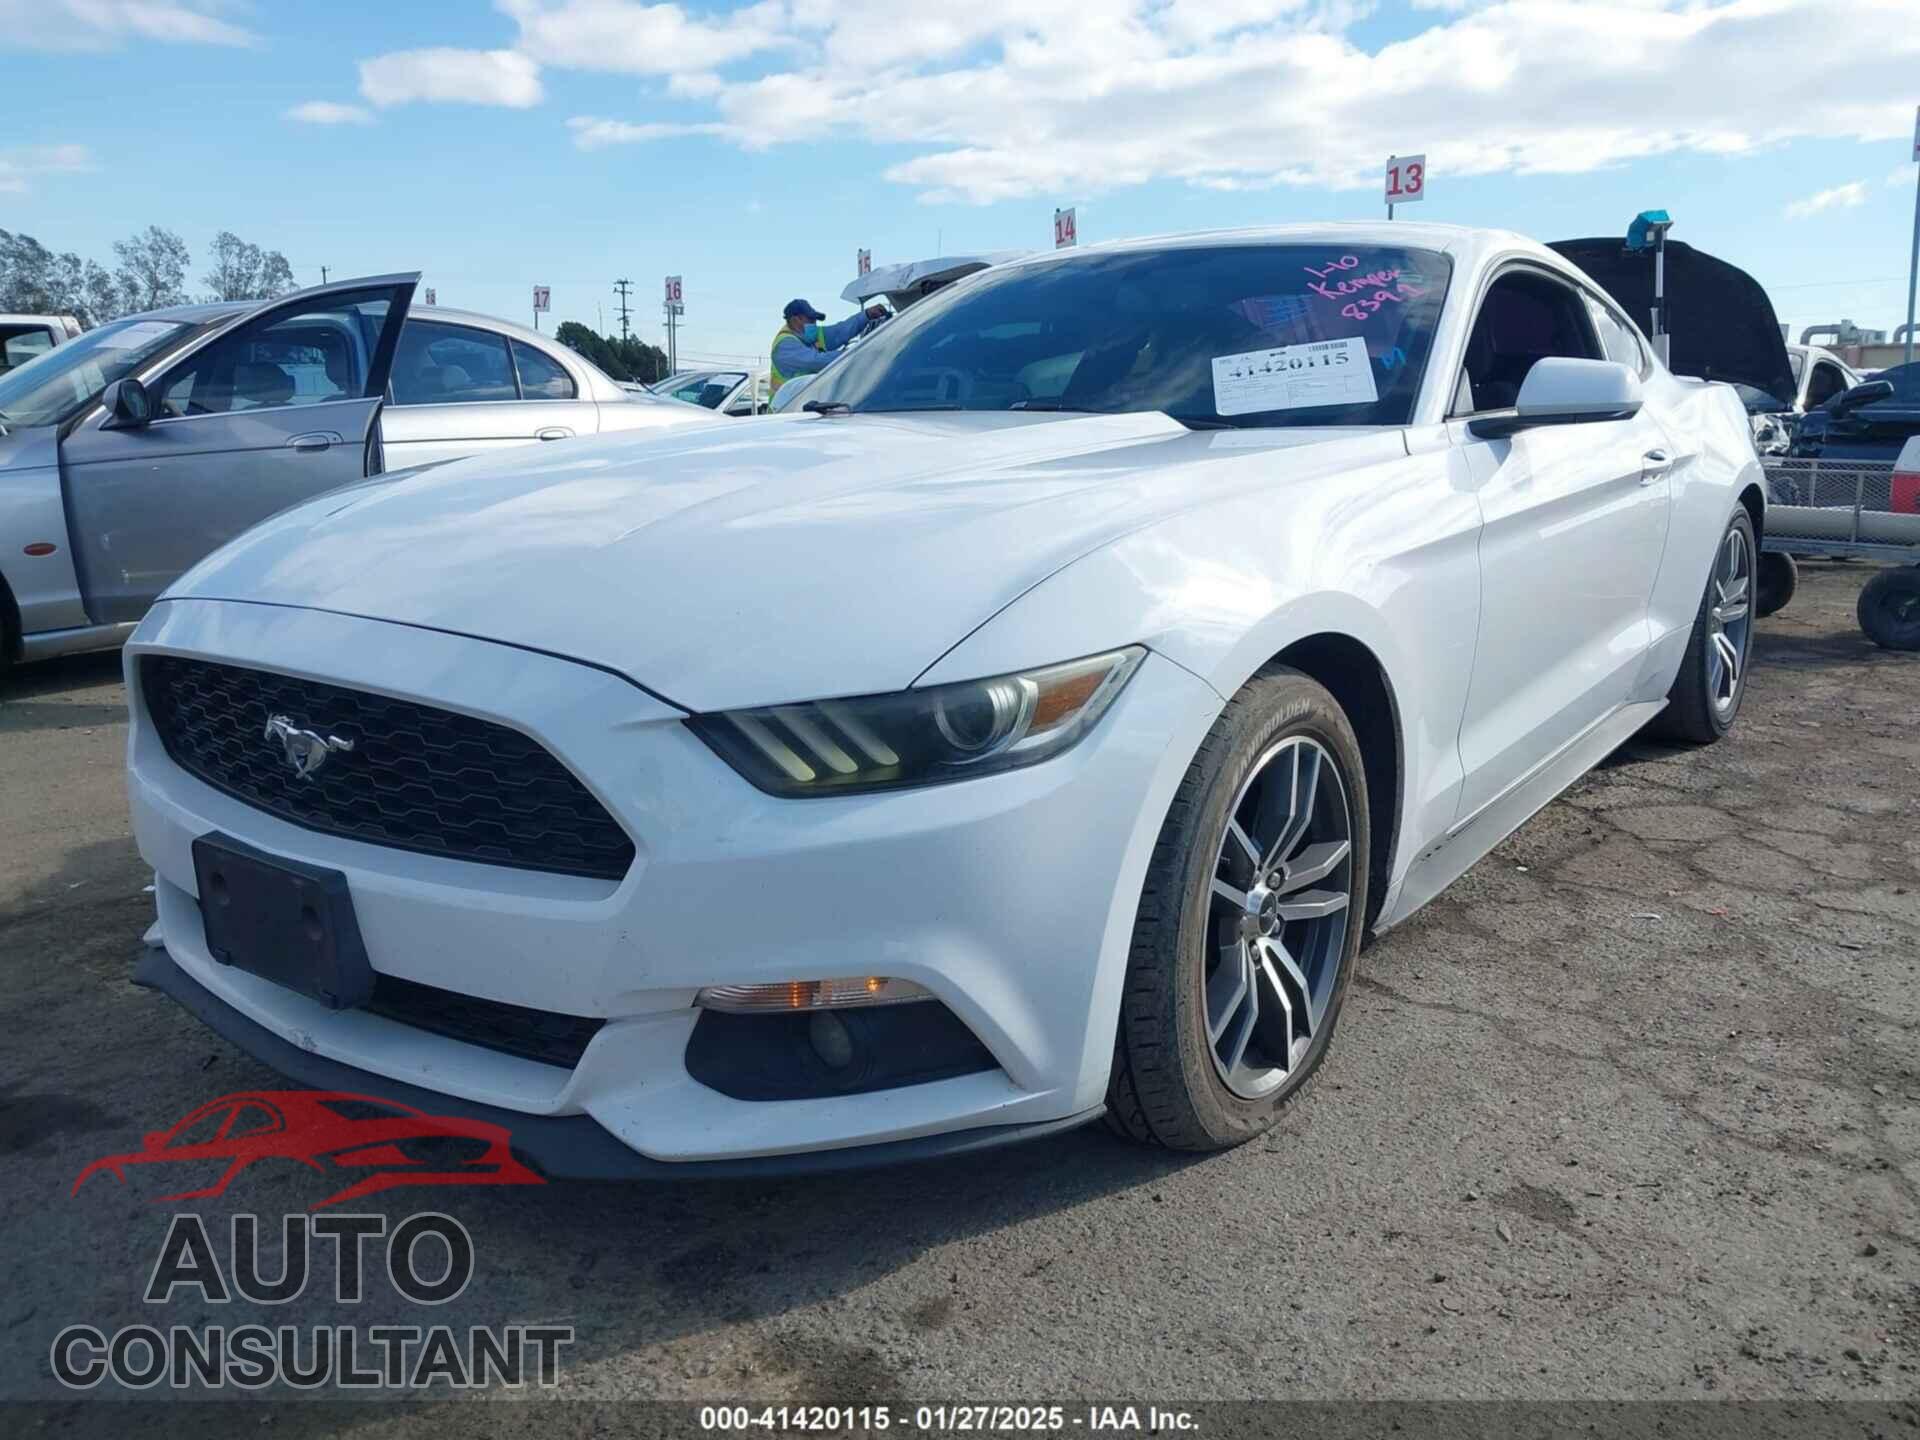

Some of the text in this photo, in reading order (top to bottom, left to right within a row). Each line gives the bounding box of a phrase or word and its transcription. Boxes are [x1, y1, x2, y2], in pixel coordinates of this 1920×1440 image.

[1387, 163, 1422, 196] 13
[1055, 215, 1075, 244] 14
[858, 256, 871, 274] 15
[1303, 255, 1359, 279] 1-10
[534, 291, 550, 308] 17
[665, 282, 682, 301] 16
[1227, 351, 1350, 378] 41420115
